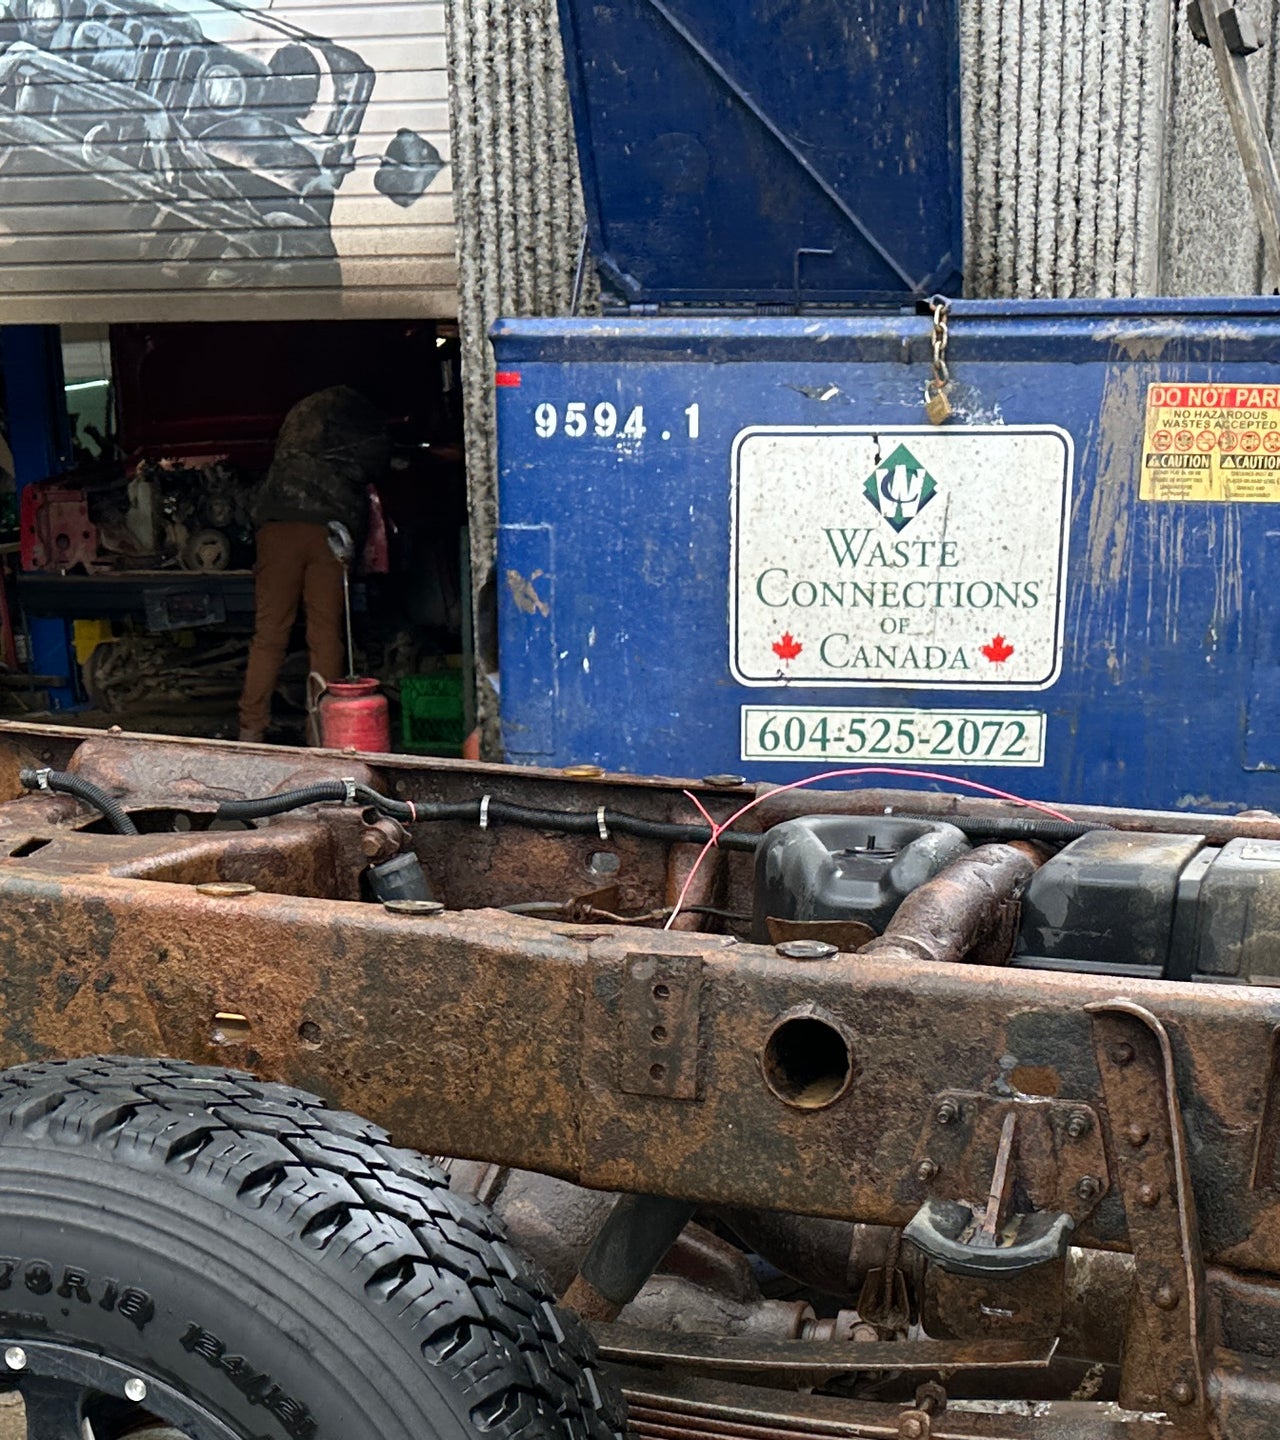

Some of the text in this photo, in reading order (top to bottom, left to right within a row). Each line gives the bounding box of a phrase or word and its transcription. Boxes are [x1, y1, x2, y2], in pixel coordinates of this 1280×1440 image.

[1151, 388, 1181, 406] DO
[1188, 388, 1230, 407] NOT
[1173, 410, 1268, 420] NO HAZARDOUS
[1162, 420, 1278, 430] WASTES ACCEPTED
[1160, 455, 1210, 468] CAUTION
[758, 716, 1027, 756] 604-525-2072
